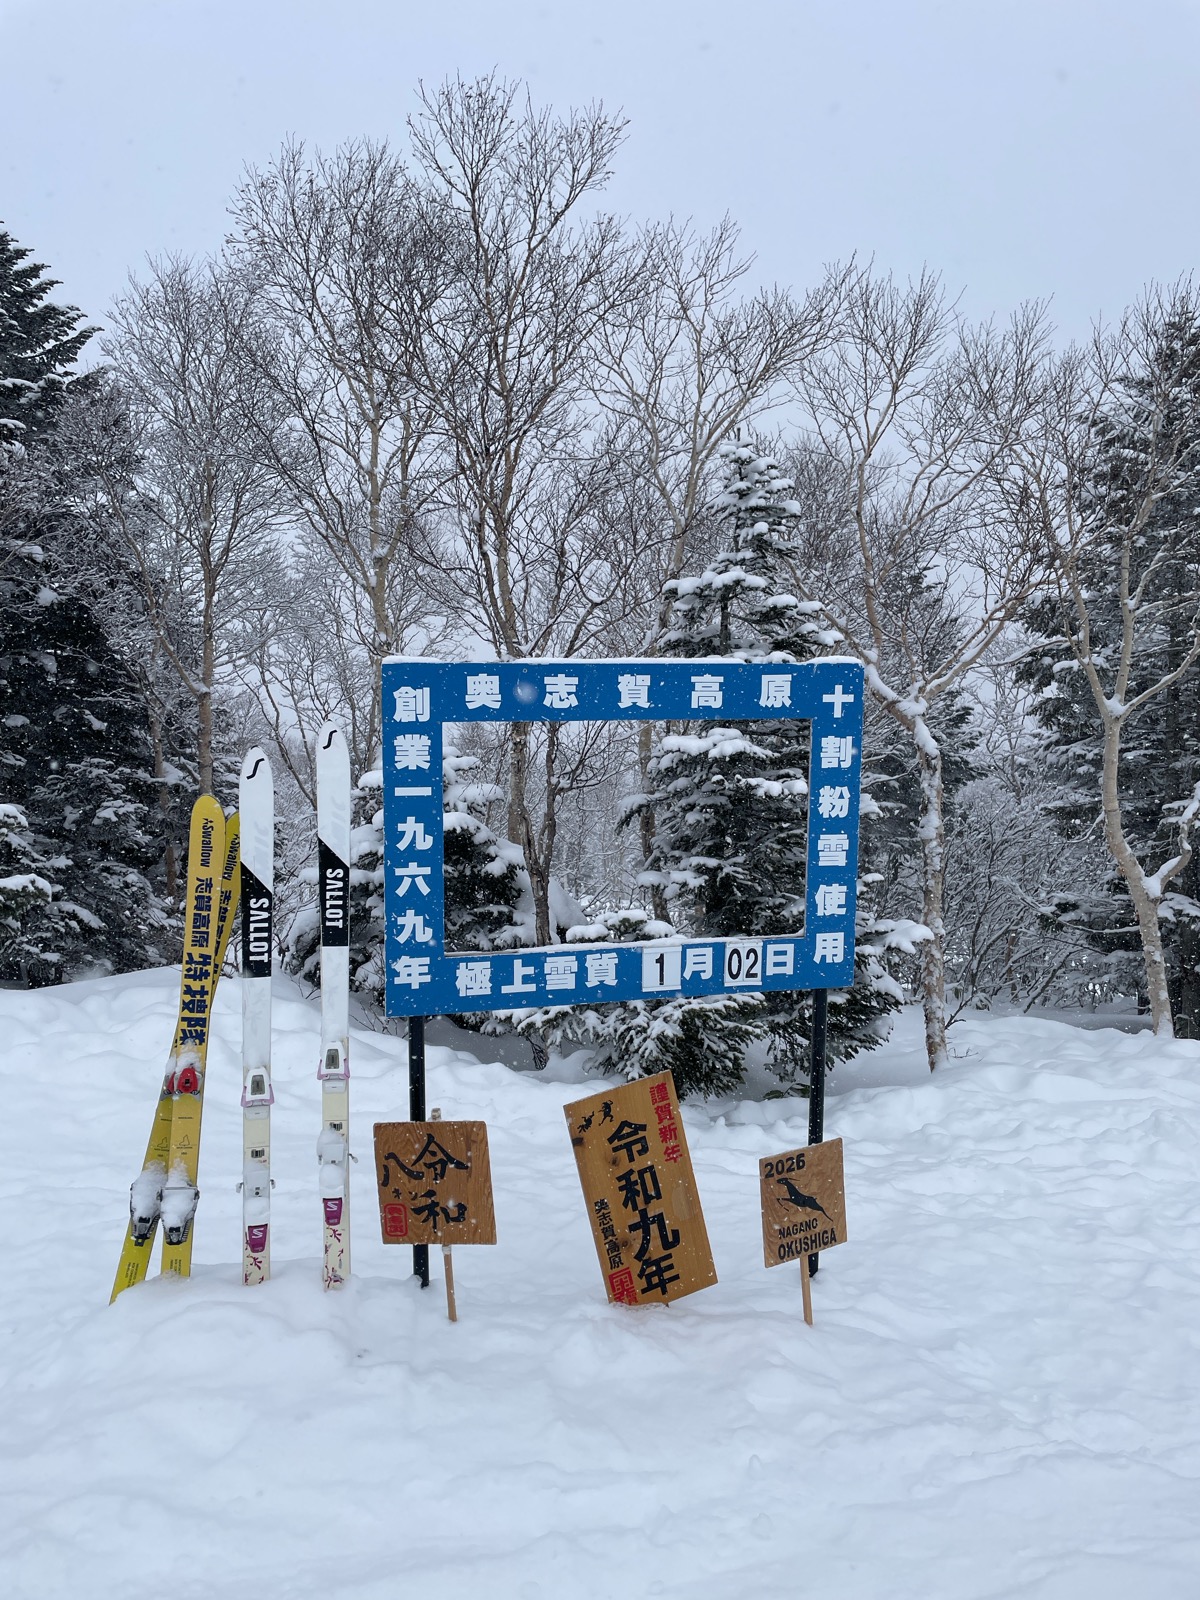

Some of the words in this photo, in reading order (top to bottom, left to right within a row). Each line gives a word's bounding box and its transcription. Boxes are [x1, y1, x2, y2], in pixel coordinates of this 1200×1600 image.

[464, 673, 793, 710] 奥志賀高原
[200, 824, 214, 868] Swallow
[392, 686, 434, 991] 創業一九六九年
[813, 684, 855, 965] 十割粉雪使用
[222, 840, 241, 881] Swallow
[190, 877, 214, 948] 志賀高原
[325, 868, 344, 929] SALLOT
[249, 898, 270, 963] SALLOT
[456, 952, 620, 998] 極上雪質
[649, 1081, 684, 1164] 謹賀新年
[764, 1152, 806, 1179] 2026
[594, 1198, 625, 1271] 奥志賀高原
[607, 1120, 681, 1296] 令和九年
[778, 1218, 819, 1240] NAGANO
[778, 1227, 838, 1261] OKUSHIGA
